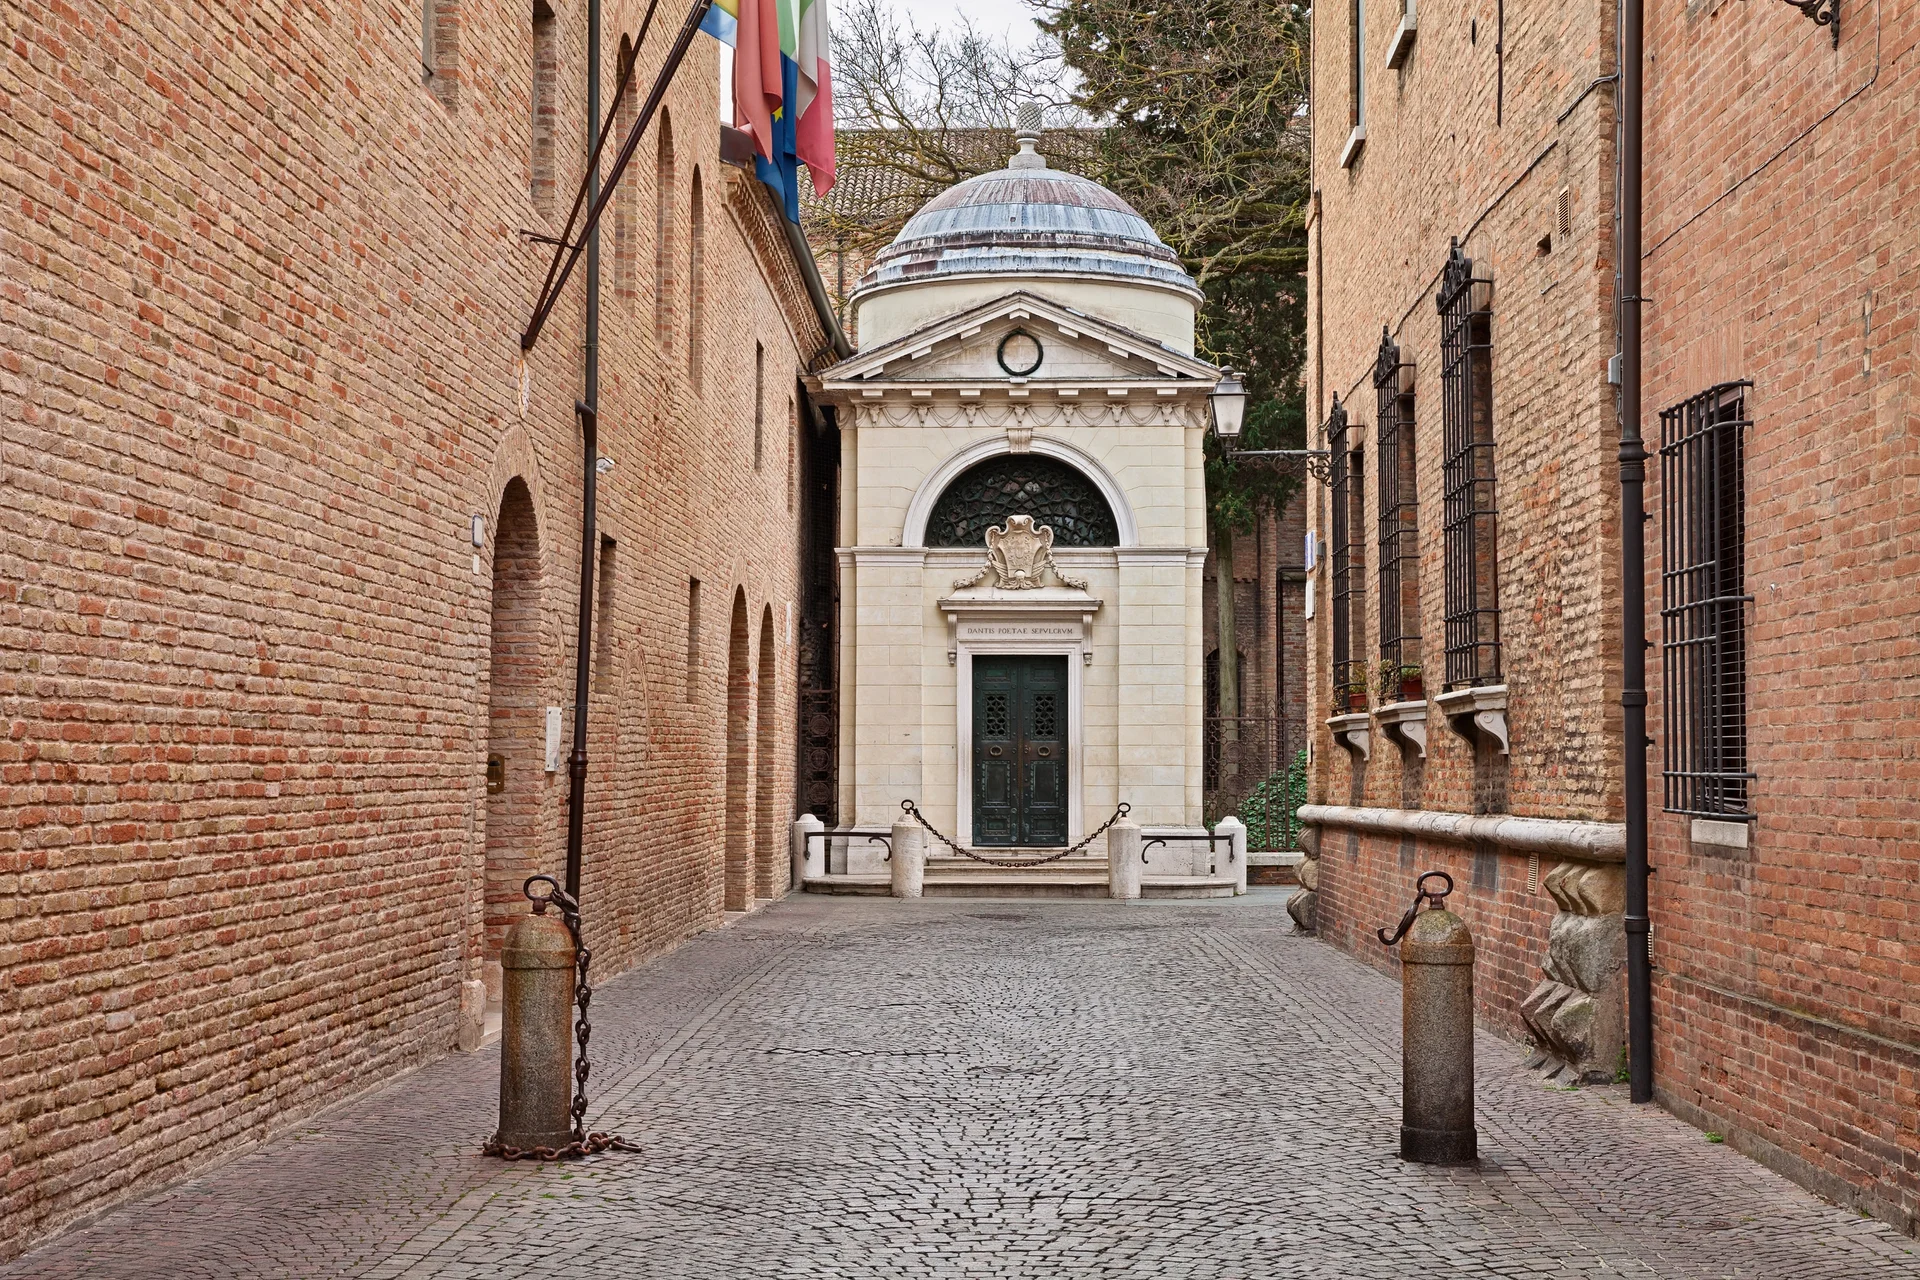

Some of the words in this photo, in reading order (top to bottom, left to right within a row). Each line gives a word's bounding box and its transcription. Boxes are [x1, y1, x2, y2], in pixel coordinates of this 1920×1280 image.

[967, 627, 995, 635] DANTIS
[998, 627, 1028, 635] POETAE
[1031, 627, 1073, 635] SEPVLCRVM
